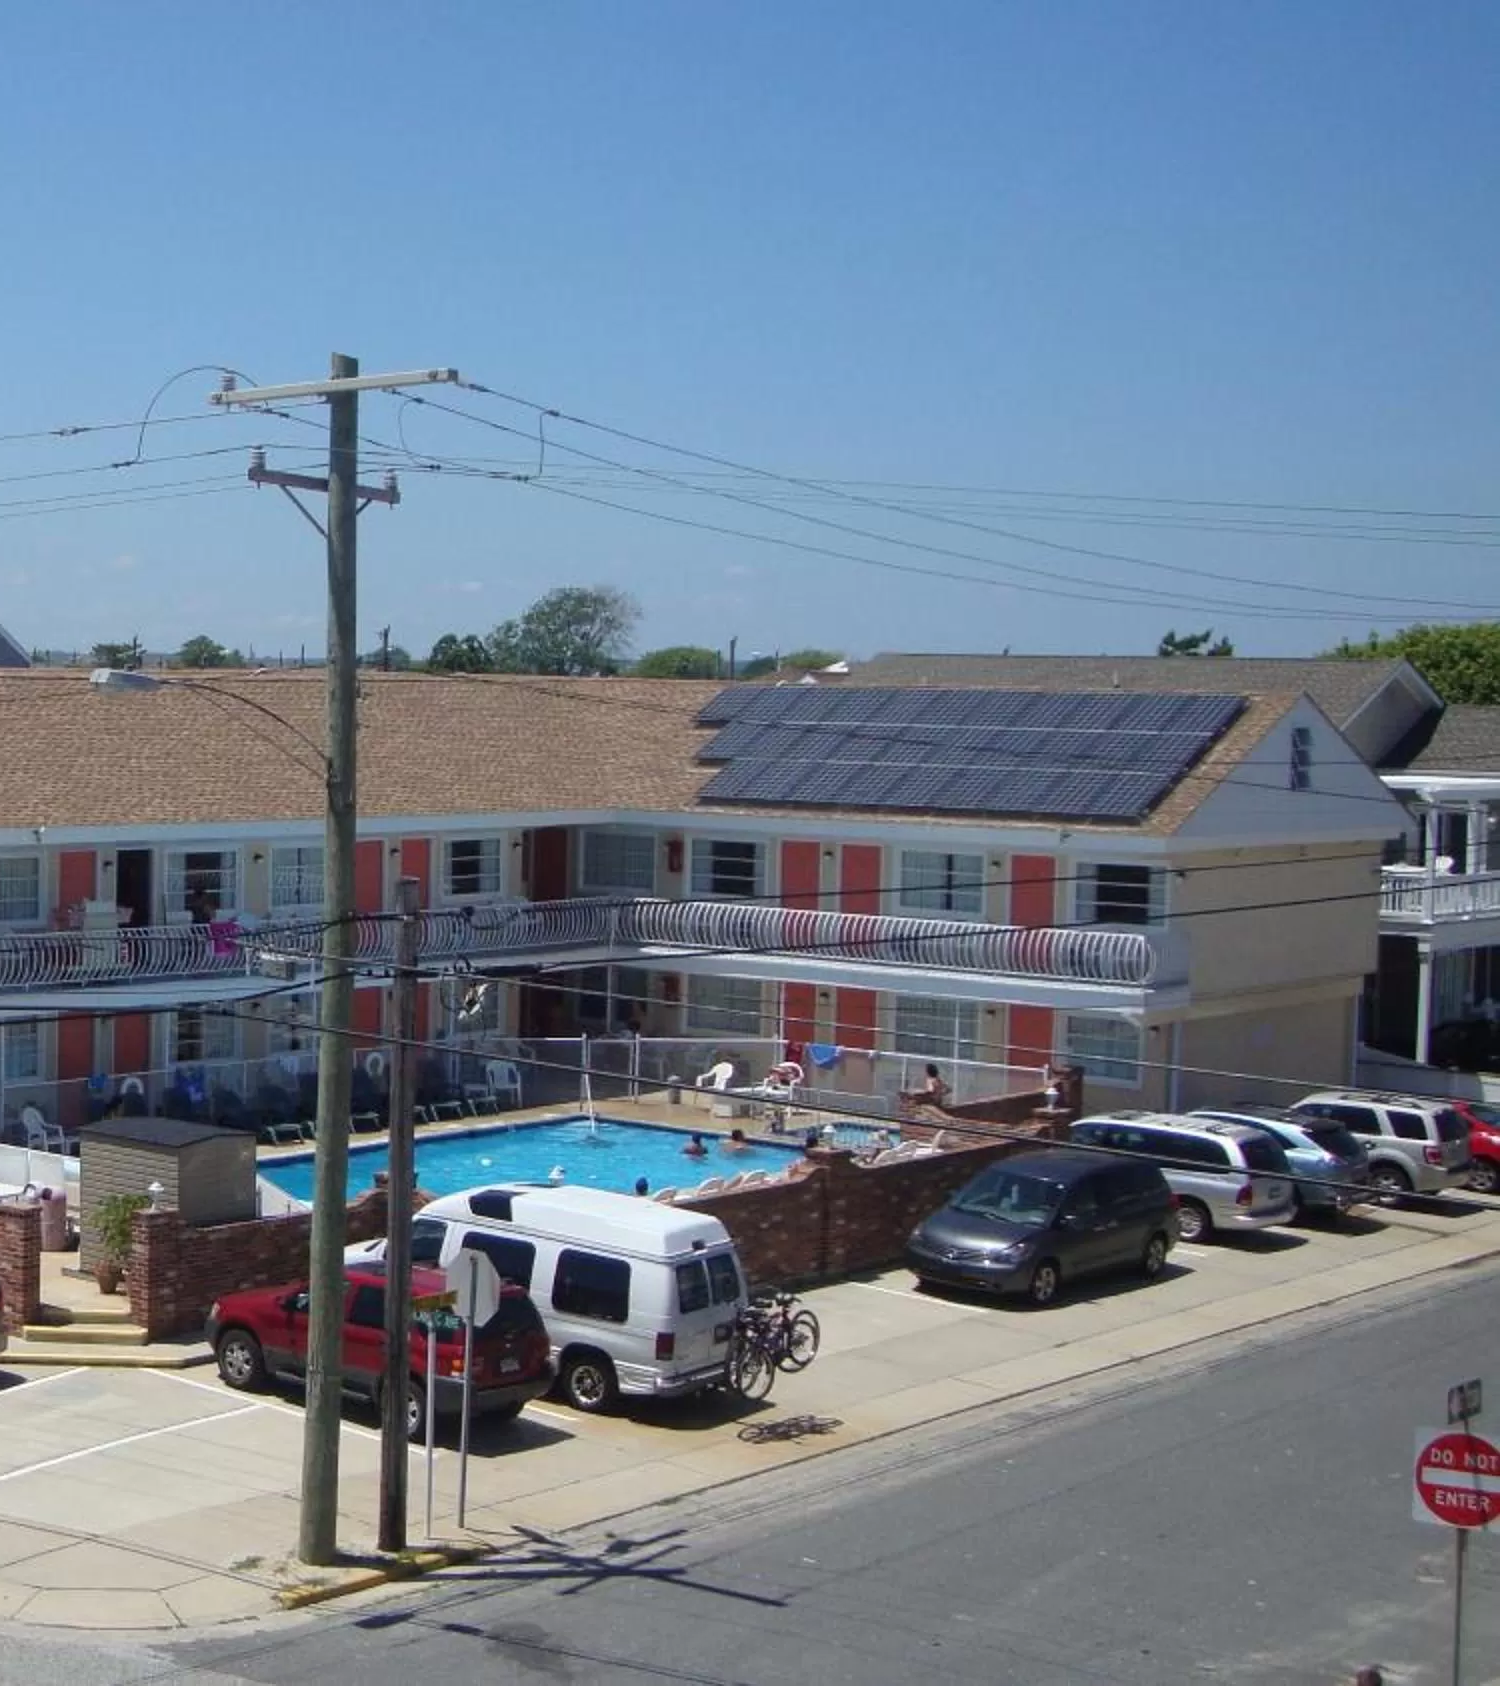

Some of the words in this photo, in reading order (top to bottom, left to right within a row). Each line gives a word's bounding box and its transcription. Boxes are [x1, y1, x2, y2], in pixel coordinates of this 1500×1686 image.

[1431, 1447, 1454, 1466] DO
[1463, 1451, 1499, 1471] NOT
[1435, 1489, 1490, 1514] ENTER
